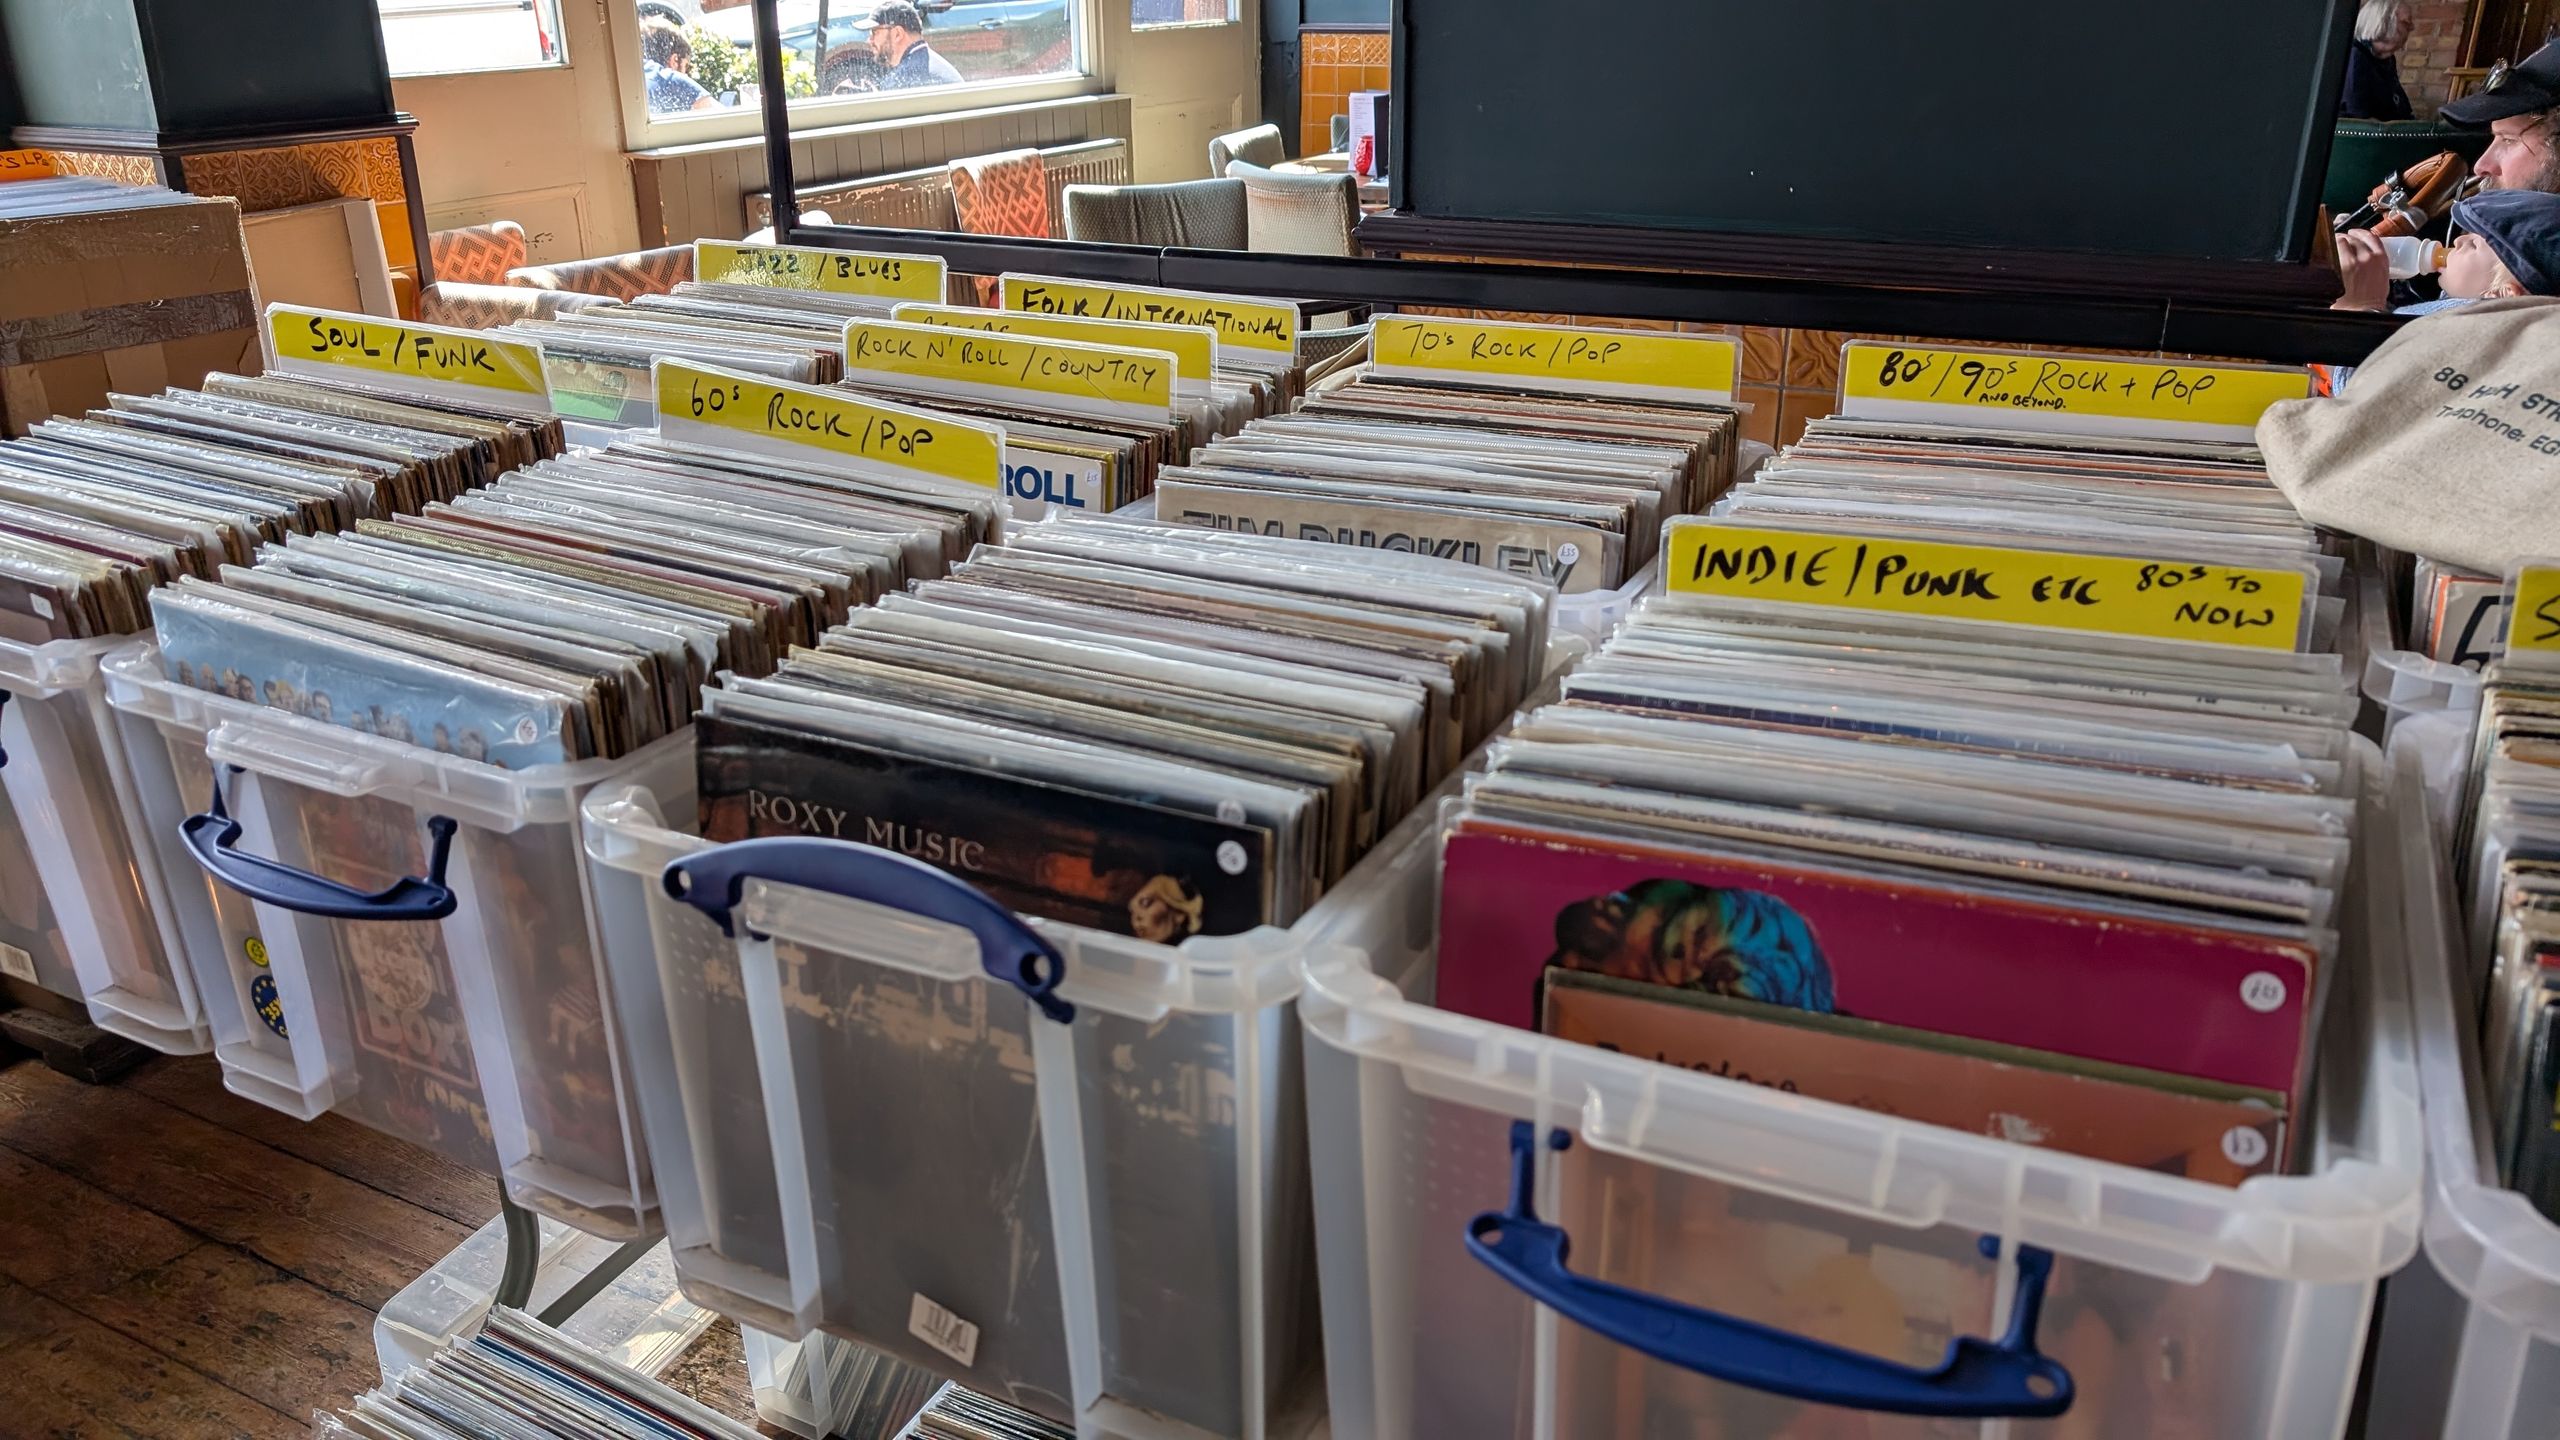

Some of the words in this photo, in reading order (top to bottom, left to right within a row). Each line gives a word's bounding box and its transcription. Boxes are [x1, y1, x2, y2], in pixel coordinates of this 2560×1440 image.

[856, 330, 917, 360] ROCK
[1979, 392, 2009, 404] AND
[2029, 361, 2108, 397] ROCK
[2151, 369, 2216, 405] POP
[2434, 366, 2469, 391] 86
[2468, 382, 2520, 399] HH
[1000, 464, 1085, 507] ROLL
[2031, 575, 2101, 605] ETC
[2226, 575, 2261, 593] TO
[2174, 602, 2274, 629] NOW
[749, 789, 848, 836] ROXY
[865, 816, 985, 872] MUSIC
